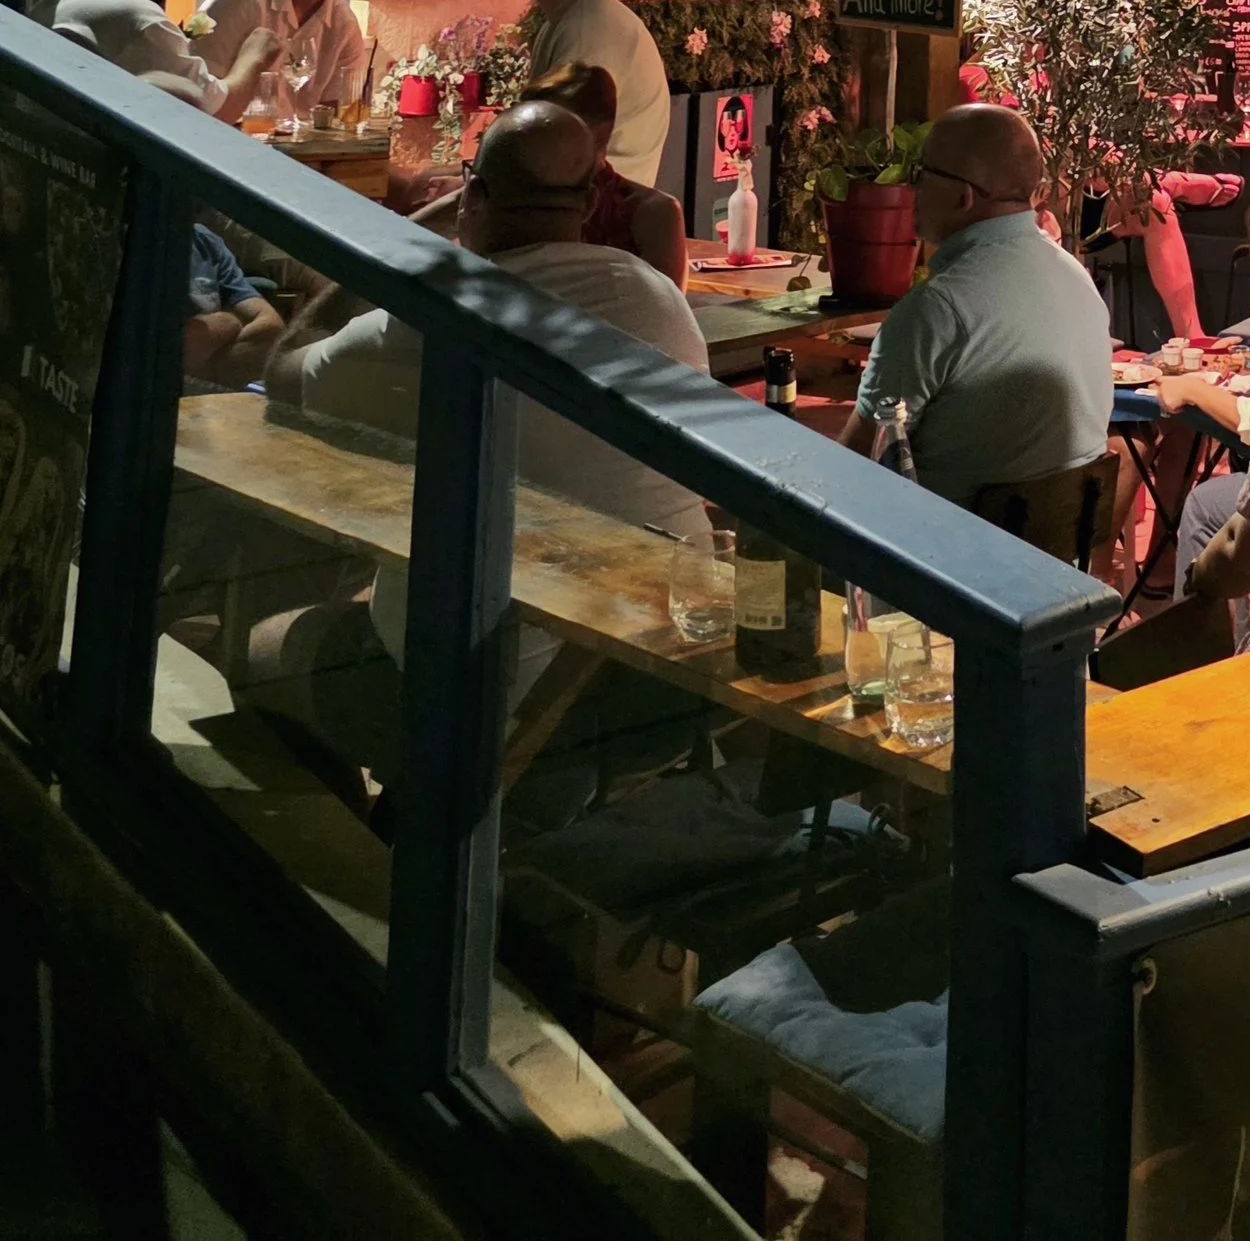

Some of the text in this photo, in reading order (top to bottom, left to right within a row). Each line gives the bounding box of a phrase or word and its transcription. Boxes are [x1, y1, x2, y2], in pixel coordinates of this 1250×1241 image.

[50, 151, 77, 179] WINE
[79, 165, 96, 189] BAR
[39, 355, 80, 415] TASTE
